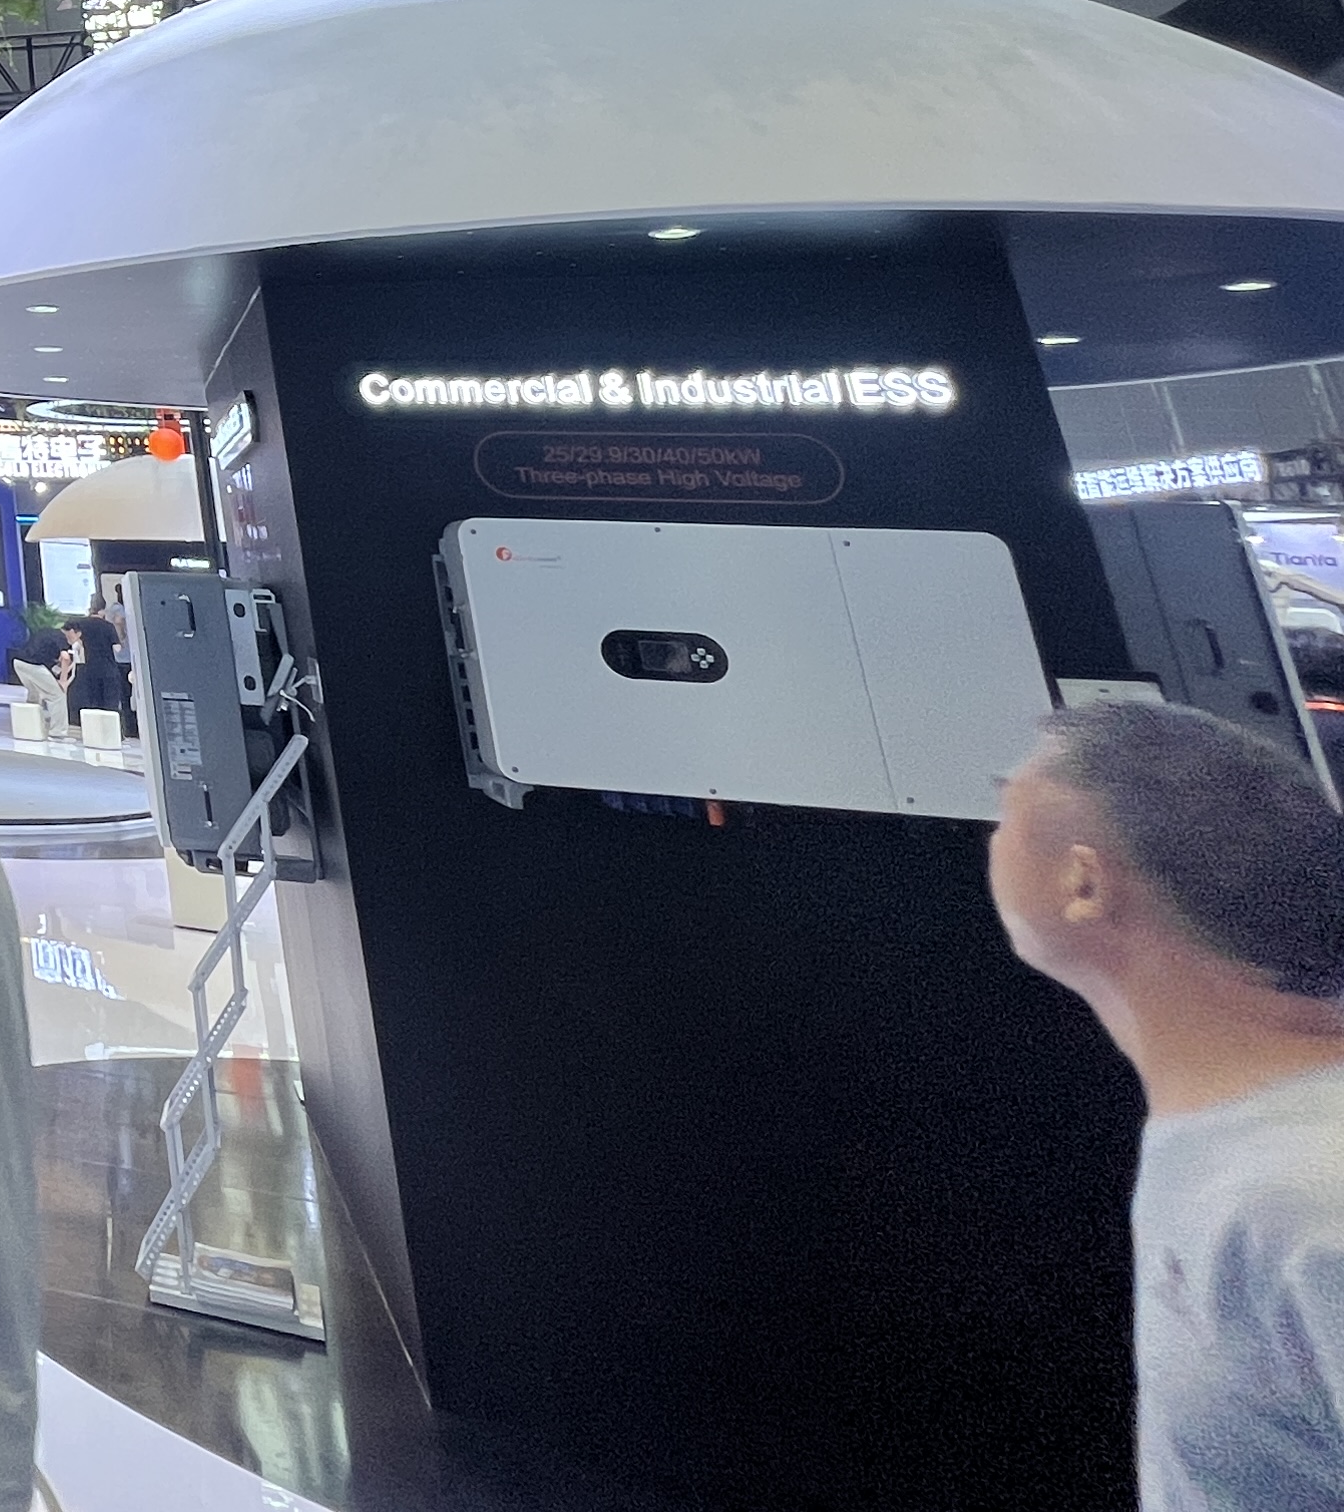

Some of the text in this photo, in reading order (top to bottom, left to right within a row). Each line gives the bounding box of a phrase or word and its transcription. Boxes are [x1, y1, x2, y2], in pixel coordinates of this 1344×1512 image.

[359, 366, 955, 408] Commercial & Industrial ESS
[515, 466, 803, 492] Three-phase High Voltage
